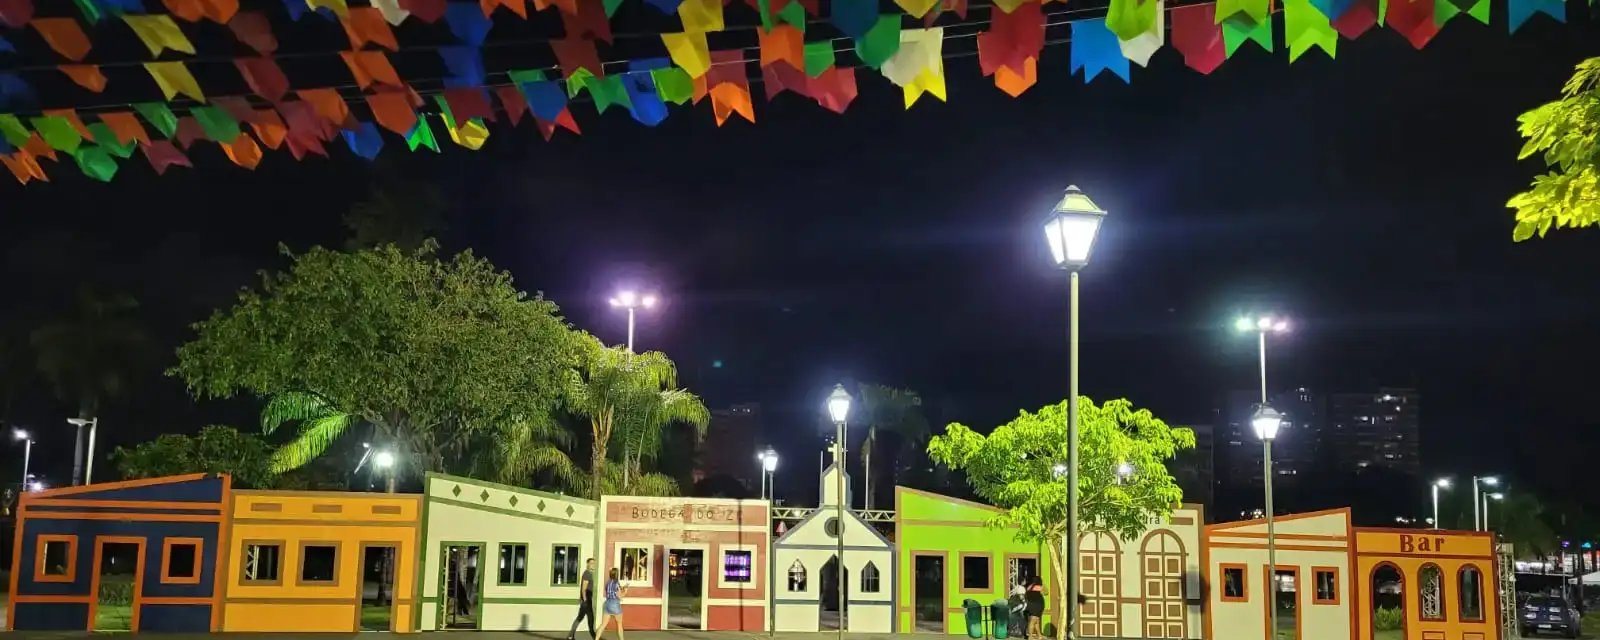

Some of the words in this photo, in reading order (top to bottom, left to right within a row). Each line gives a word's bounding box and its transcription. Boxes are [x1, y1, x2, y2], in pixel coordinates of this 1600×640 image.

[631, 506, 685, 519] BODEGA
[697, 509, 714, 520] DO
[1399, 534, 1445, 553] Bar
